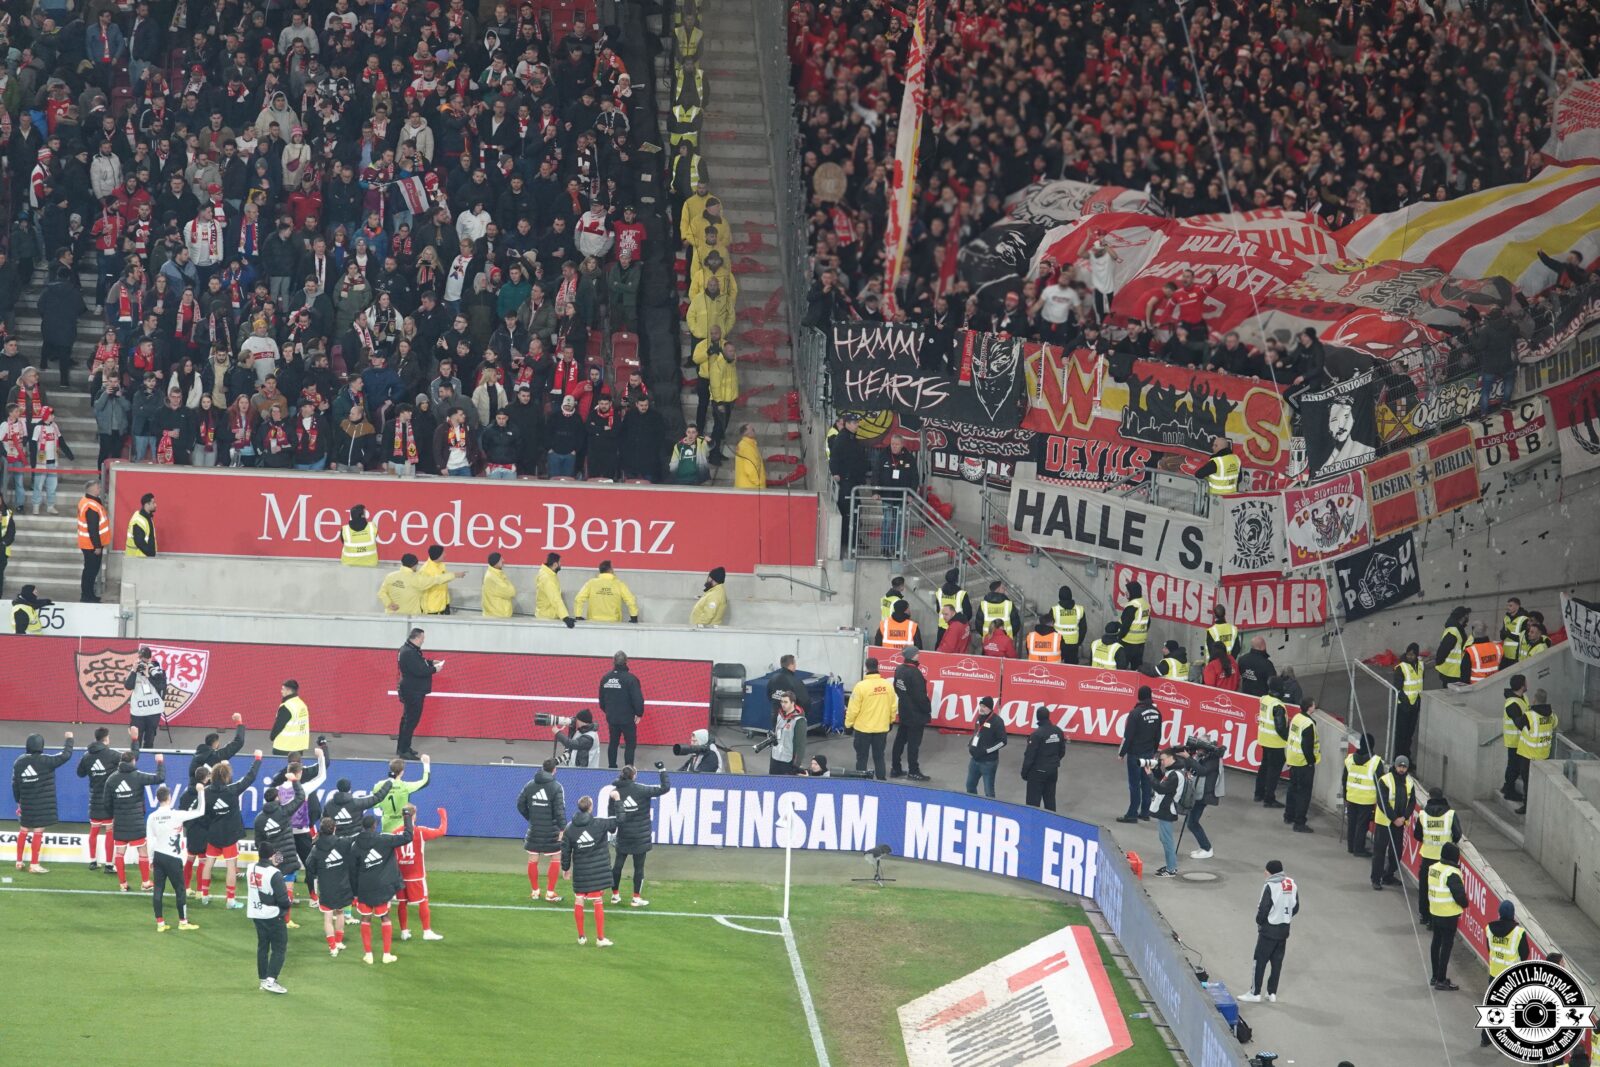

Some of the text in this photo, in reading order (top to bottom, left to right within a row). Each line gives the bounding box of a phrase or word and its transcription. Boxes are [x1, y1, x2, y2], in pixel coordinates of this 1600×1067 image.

[845, 367, 951, 412] HEARTS
[1045, 434, 1152, 483] DEVILS
[1342, 452, 1377, 469] UNIONE
[1372, 447, 1474, 501] EISERN BERLIN
[257, 491, 677, 556] Mecedes-Benz
[1014, 488, 1147, 556] HALLE
[1178, 525, 1213, 574] S.
[1229, 551, 1276, 570] NINERS
[1116, 567, 1324, 626] SACHSENADLER
[941, 669, 995, 680] Schwarzwaldmilch
[1012, 676, 1065, 687] Schwarzwaldmilch
[1080, 682, 1133, 694] Schwarzwaldmilch
[137, 698, 160, 708] CLUB
[388, 795, 397, 813] 1
[597, 783, 879, 852] MEINSAM
[903, 800, 1021, 877] MEHR
